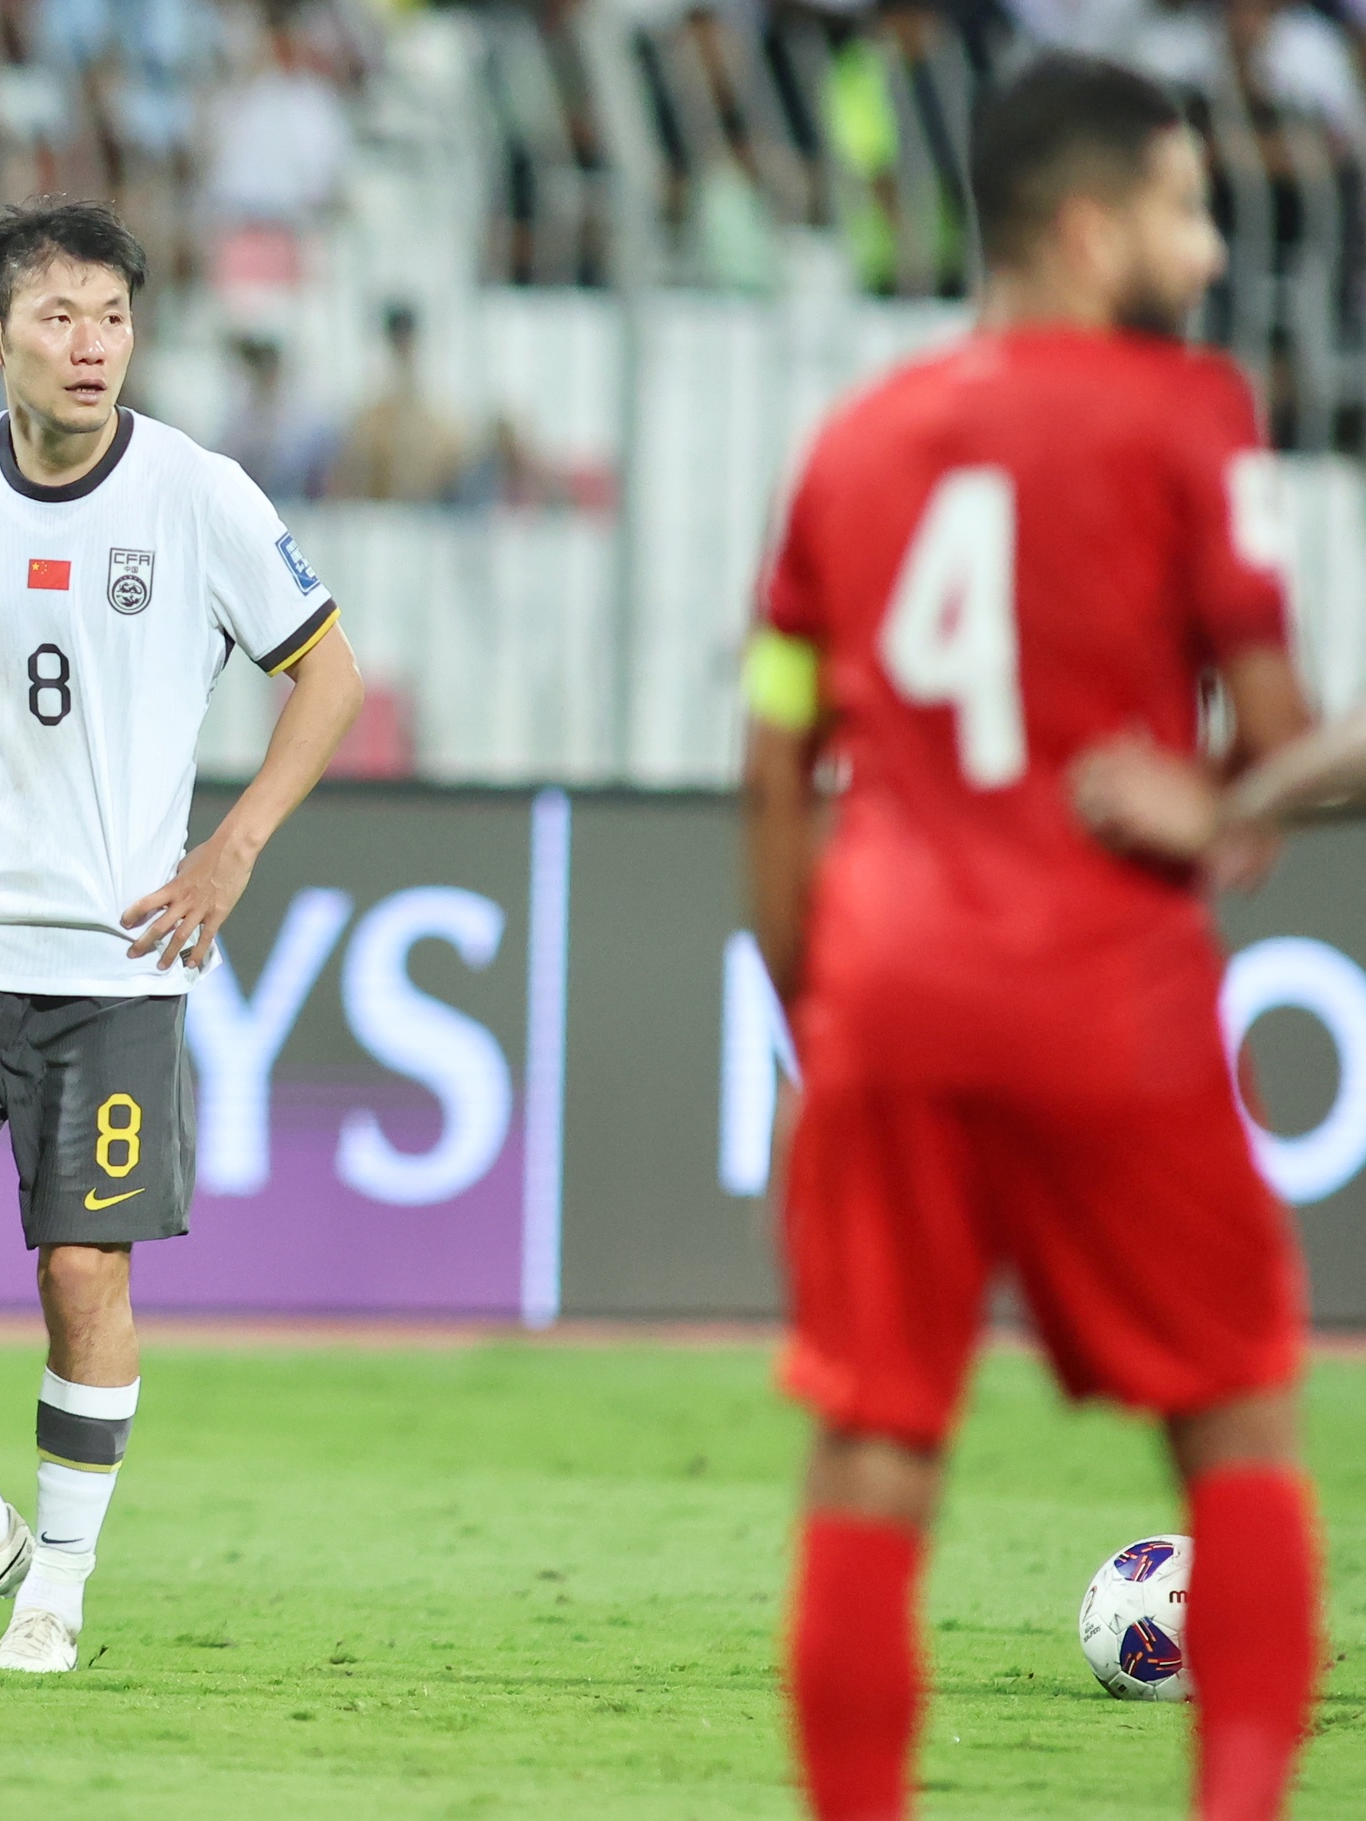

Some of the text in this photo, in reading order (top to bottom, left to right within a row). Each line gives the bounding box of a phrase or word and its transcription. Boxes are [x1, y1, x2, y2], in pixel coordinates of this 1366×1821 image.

[113, 552, 150, 566] CFA
[124, 565, 139, 574] 中国
[877, 462, 1030, 793] 4
[28, 643, 71, 726] 8
[95, 1092, 142, 1178] 8
